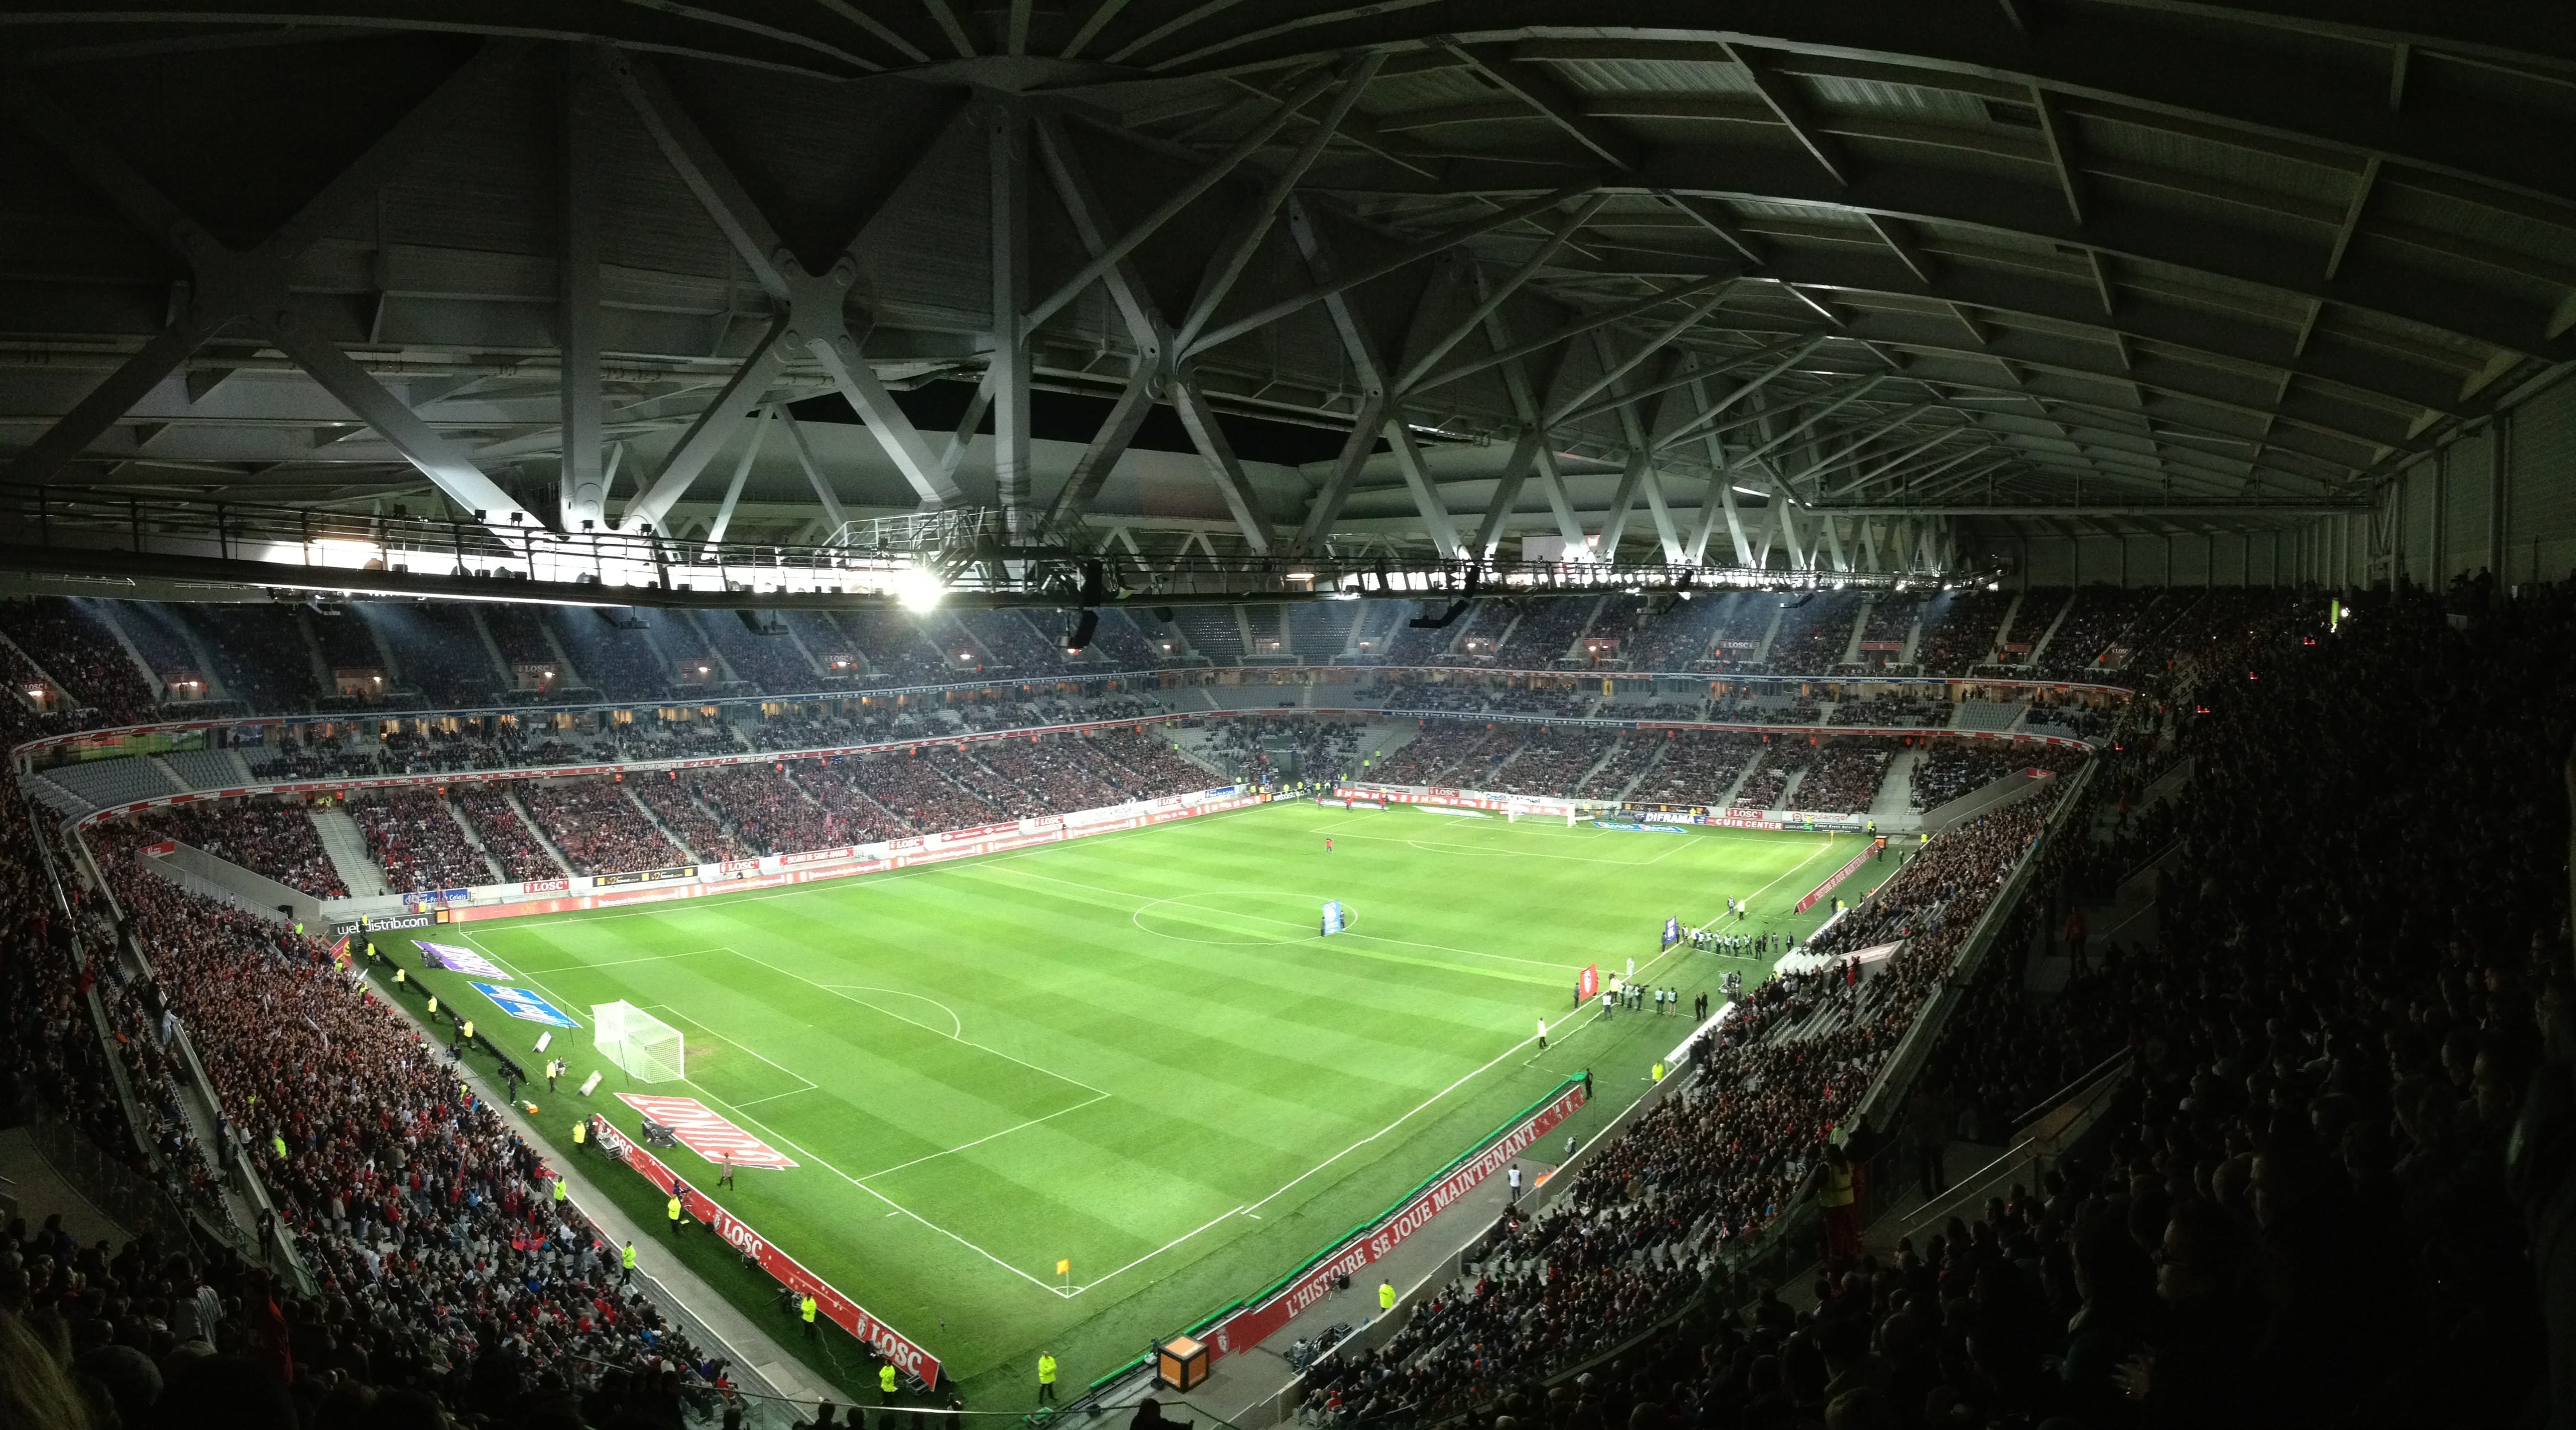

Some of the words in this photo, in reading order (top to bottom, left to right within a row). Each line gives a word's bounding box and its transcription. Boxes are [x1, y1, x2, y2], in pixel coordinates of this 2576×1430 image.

[1646, 813, 1695, 824] DIFRAMA
[1733, 810, 1758, 818] LOSC
[1041, 816, 1058, 826] LOSC
[1715, 818, 1743, 827] CUIR
[1745, 820, 1782, 830] CENTER
[897, 838, 919, 848] LOSC
[729, 860, 755, 871] LOSC
[534, 881, 563, 892] LOSC
[1286, 1247, 1366, 1318] L'HISTOIRE
[1372, 1233, 1391, 1260] SE
[1393, 1201, 1433, 1244] JOUE
[1432, 1122, 1537, 1212] MAINTENANT
[724, 1217, 763, 1260] LOSC
[871, 1323, 922, 1376] LOSC
